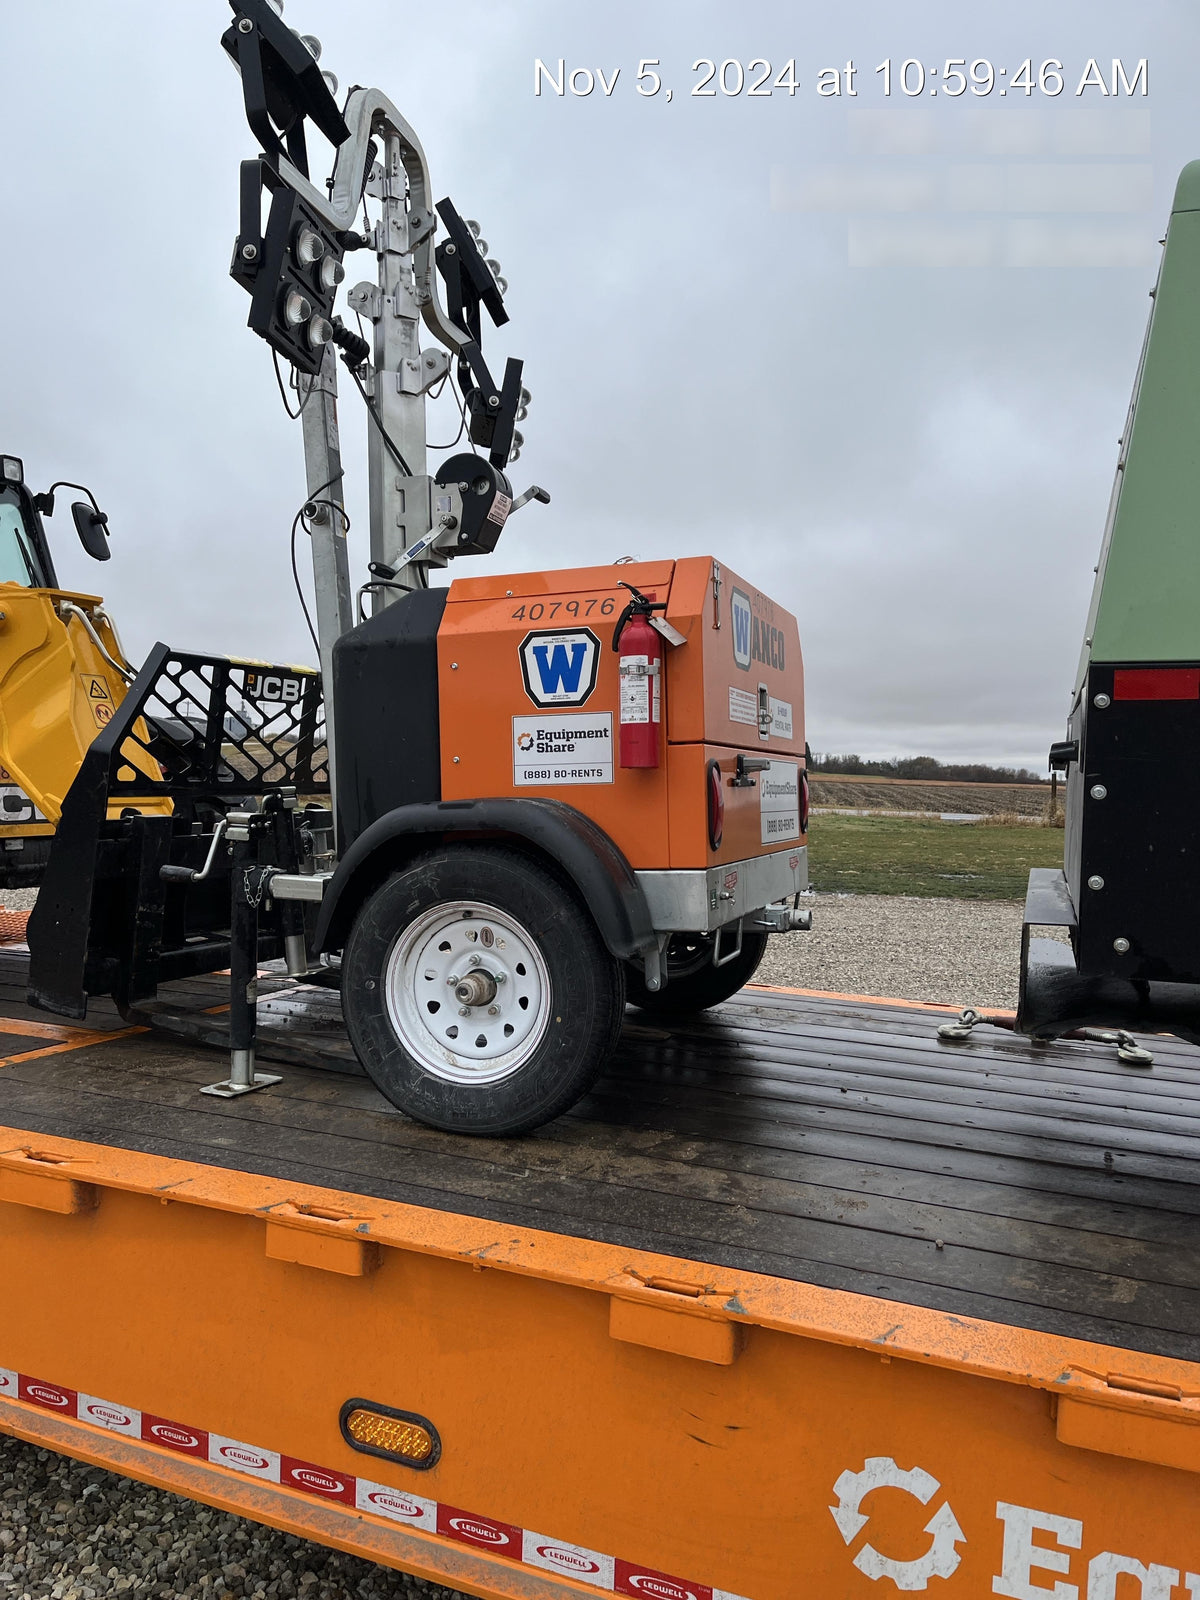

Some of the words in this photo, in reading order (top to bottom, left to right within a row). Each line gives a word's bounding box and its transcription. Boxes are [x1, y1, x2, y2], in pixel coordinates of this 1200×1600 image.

[511, 598, 615, 622] 407976
[733, 603, 785, 671] WANCO
[532, 642, 588, 694] W
[247, 675, 300, 702] JCB
[536, 727, 609, 742] Equipment
[536, 742, 576, 753] Share
[554, 768, 603, 778] 80-RENTS
[35, 1389, 60, 1402] LEDWELL
[96, 1408, 122, 1421] LEDWELL
[161, 1428, 190, 1442] LEDWELL
[229, 1450, 259, 1465] LEDWELL
[302, 1472, 333, 1488] LEDWELL
[379, 1496, 413, 1512] LEDWELL
[461, 1523, 497, 1539] LEDWELL
[549, 1551, 587, 1567] LEDWELL
[643, 1580, 683, 1599] LEDWELL
